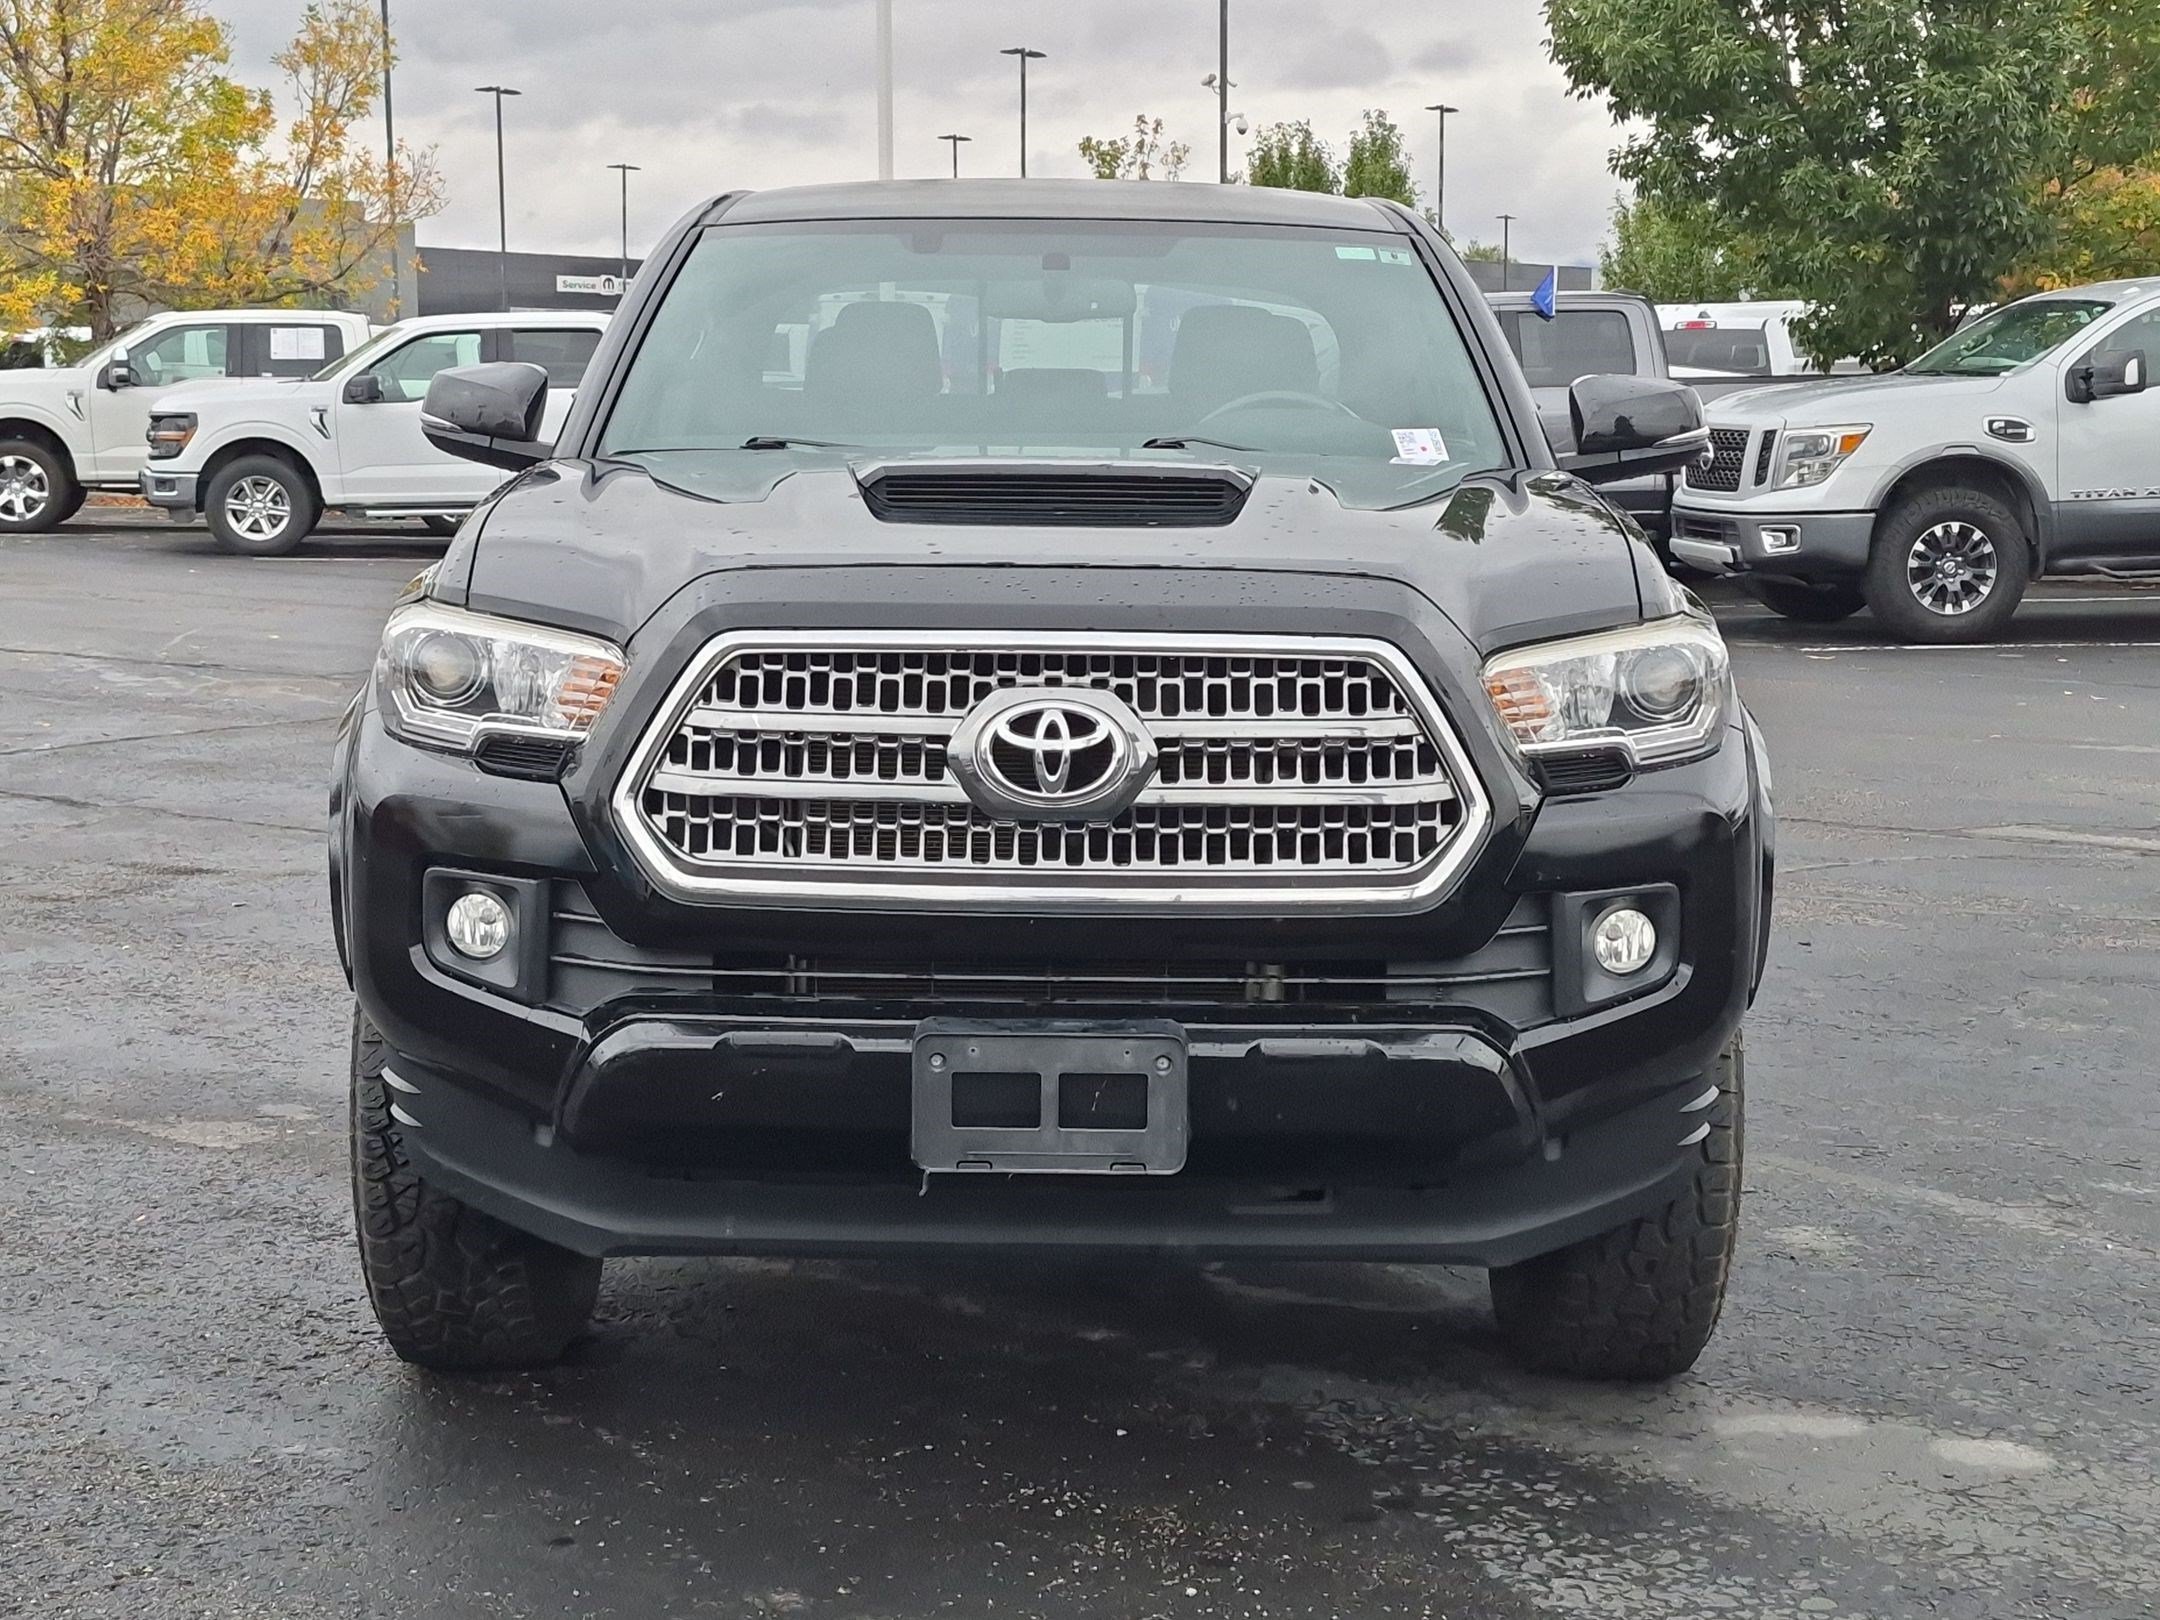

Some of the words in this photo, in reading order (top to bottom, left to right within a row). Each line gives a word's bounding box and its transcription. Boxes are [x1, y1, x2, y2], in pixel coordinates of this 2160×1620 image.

[562, 280, 596, 290] Service
[2070, 487, 2136, 498] TITAN
[2144, 487, 2160, 496] X
